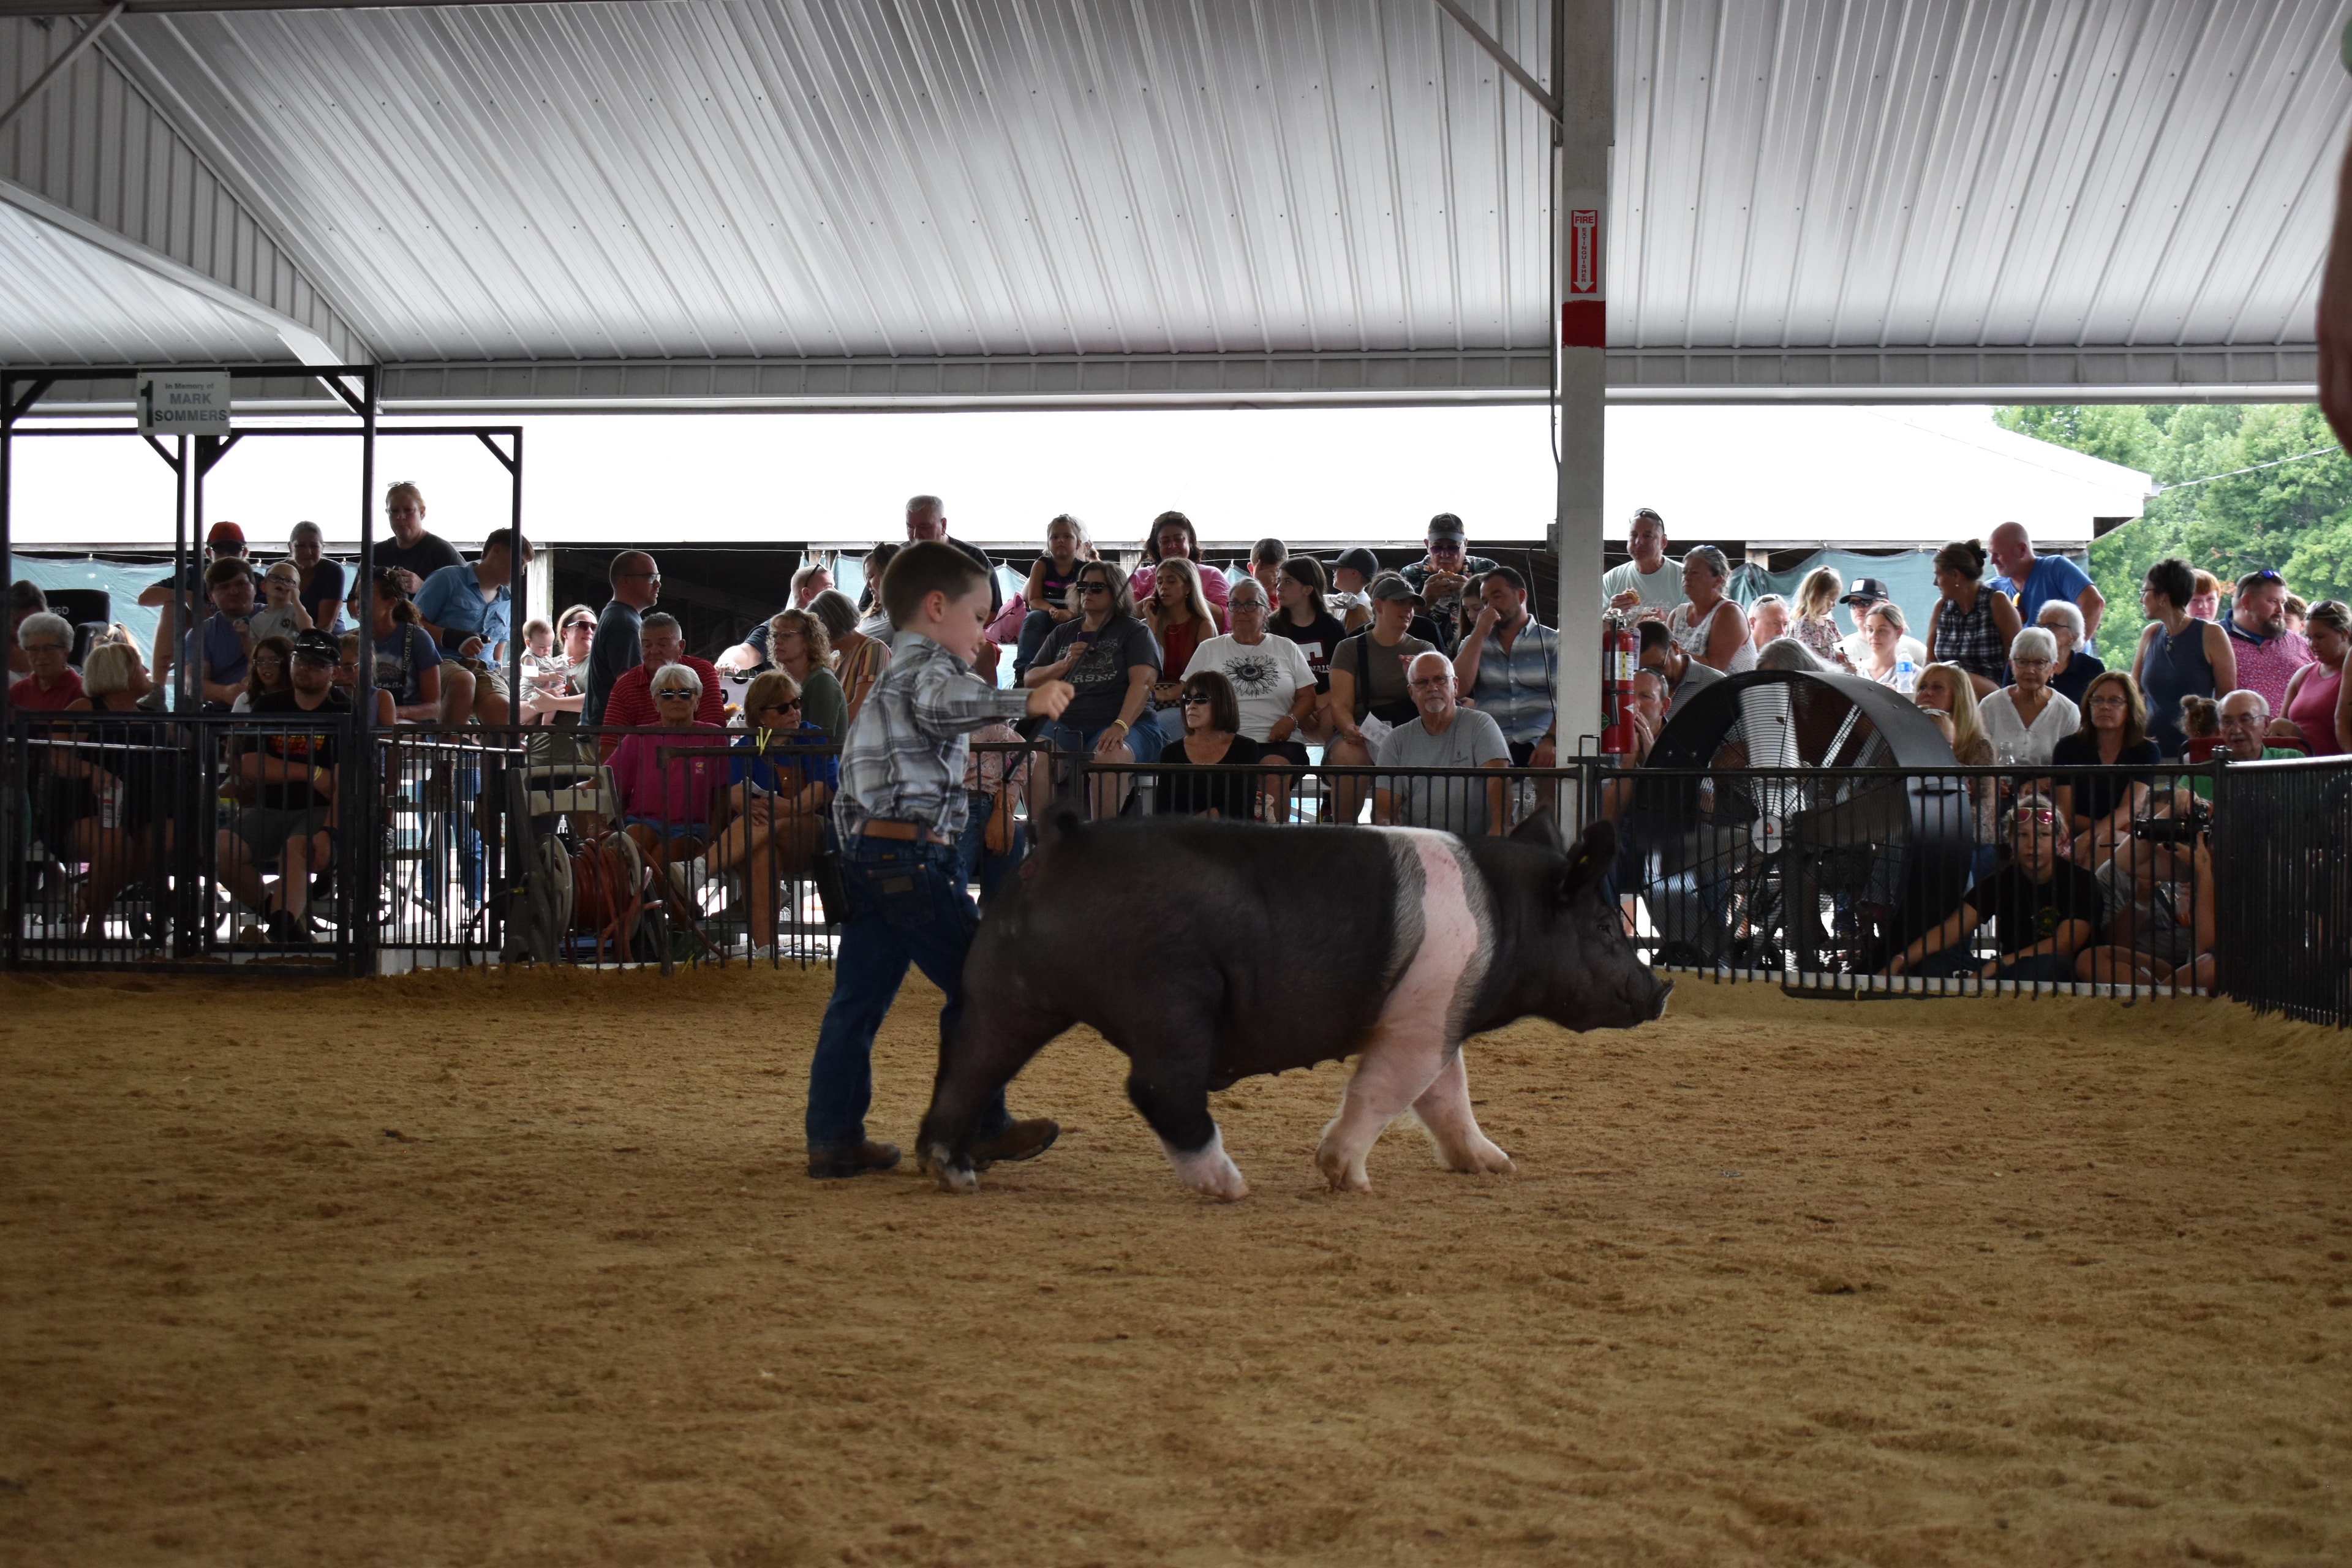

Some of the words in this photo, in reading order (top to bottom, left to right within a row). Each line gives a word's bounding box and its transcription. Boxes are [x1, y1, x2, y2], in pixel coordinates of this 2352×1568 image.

[140, 380, 154, 428] 1
[170, 393, 212, 405] MARK
[154, 410, 227, 421] SOMMERS
